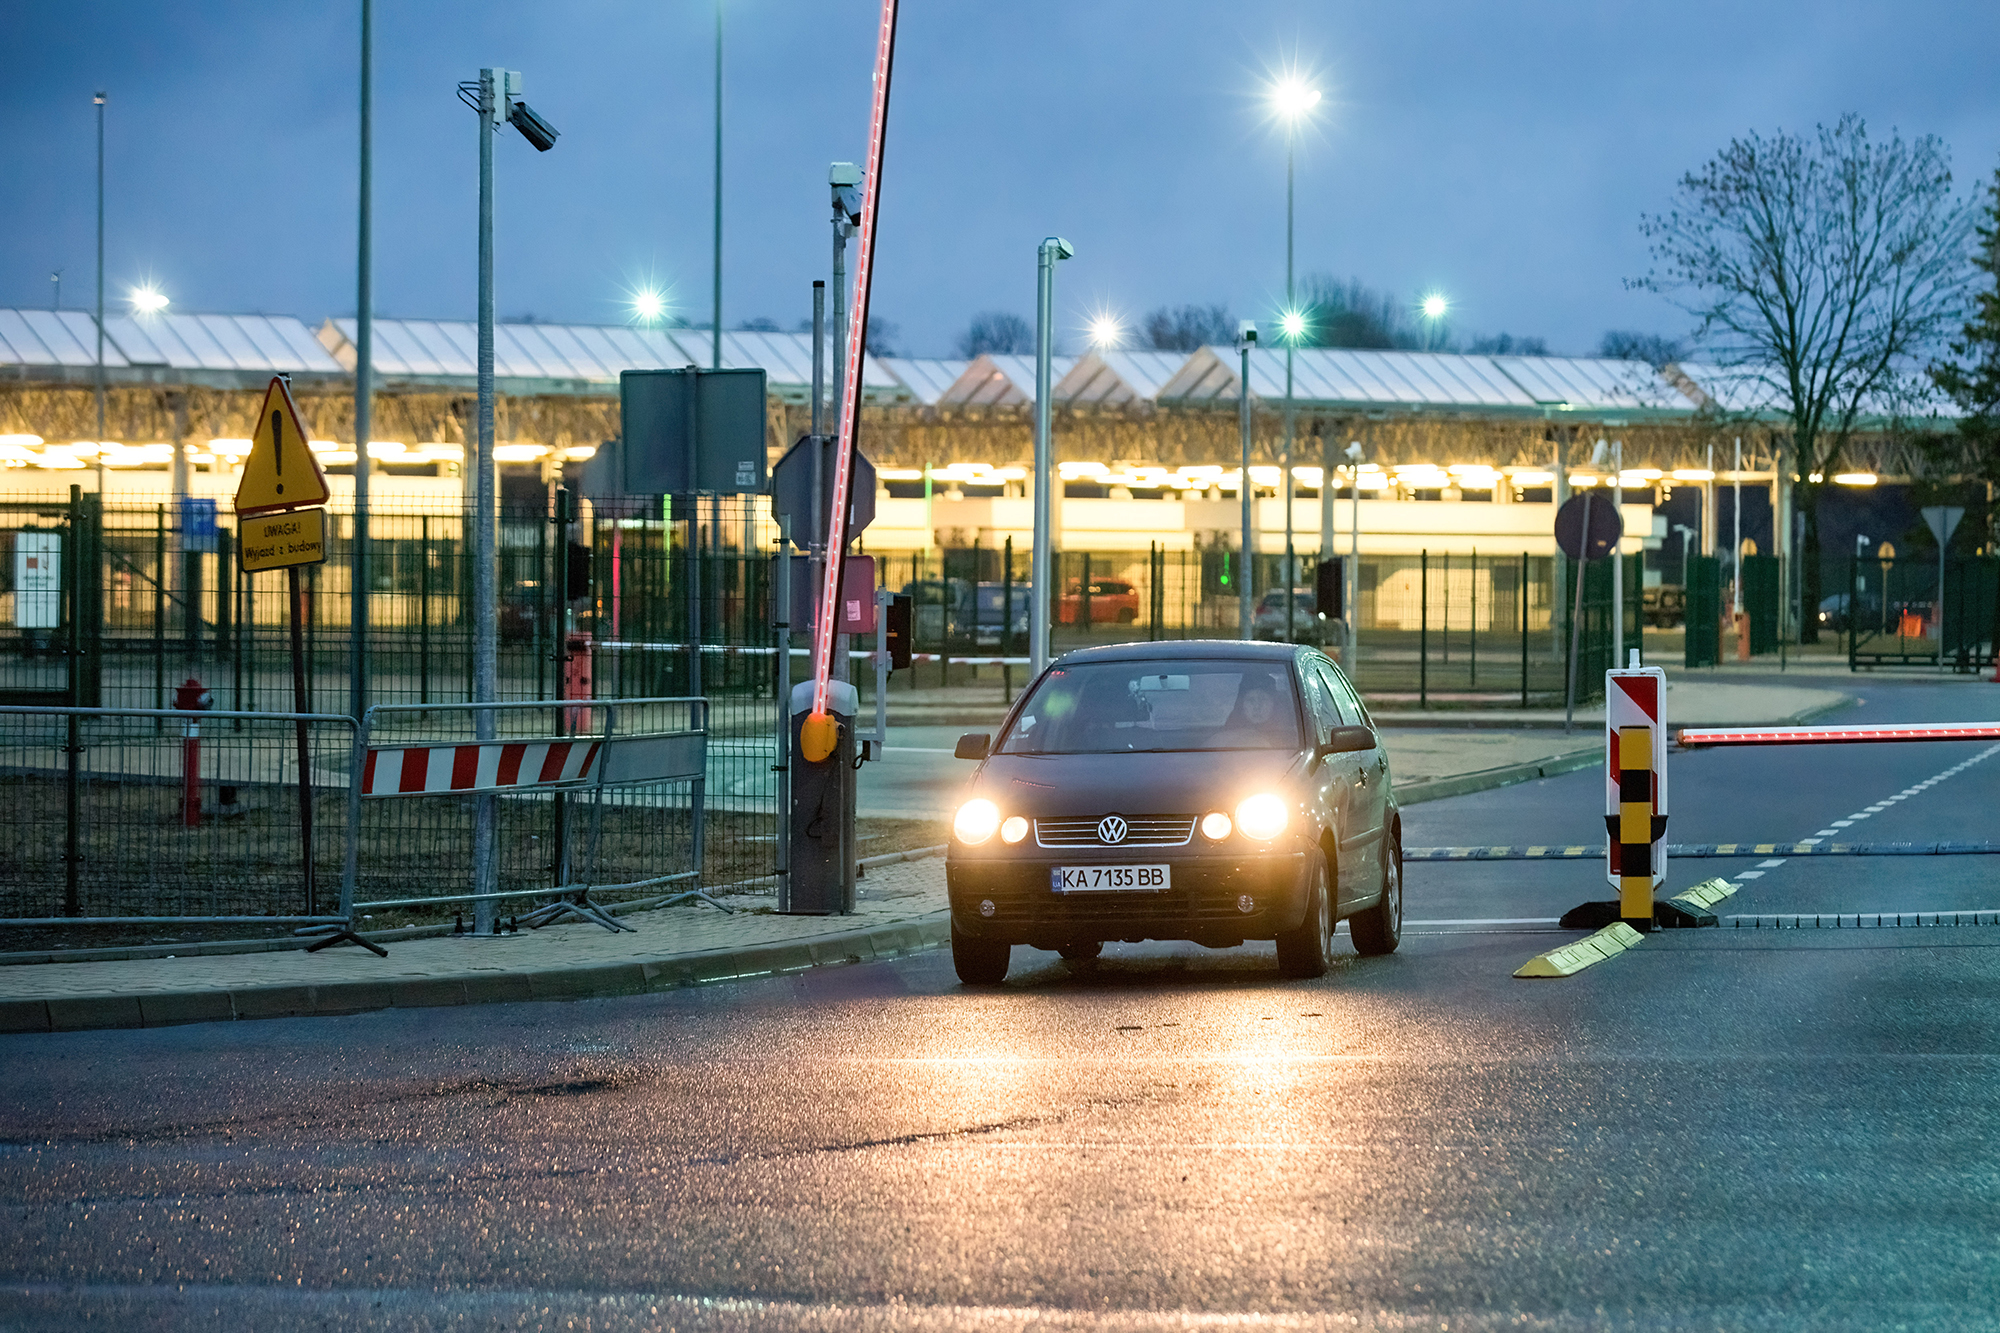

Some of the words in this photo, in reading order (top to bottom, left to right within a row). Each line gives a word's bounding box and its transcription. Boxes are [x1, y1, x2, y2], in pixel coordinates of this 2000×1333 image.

[264, 522, 301, 538] UWAGA!
[245, 545, 275, 562] Wyjazd
[288, 540, 322, 554] budowy
[1098, 816, 1127, 843] VW
[1062, 869, 1088, 888] KA
[1092, 869, 1134, 887] 7135
[1138, 868, 1164, 886] BB
